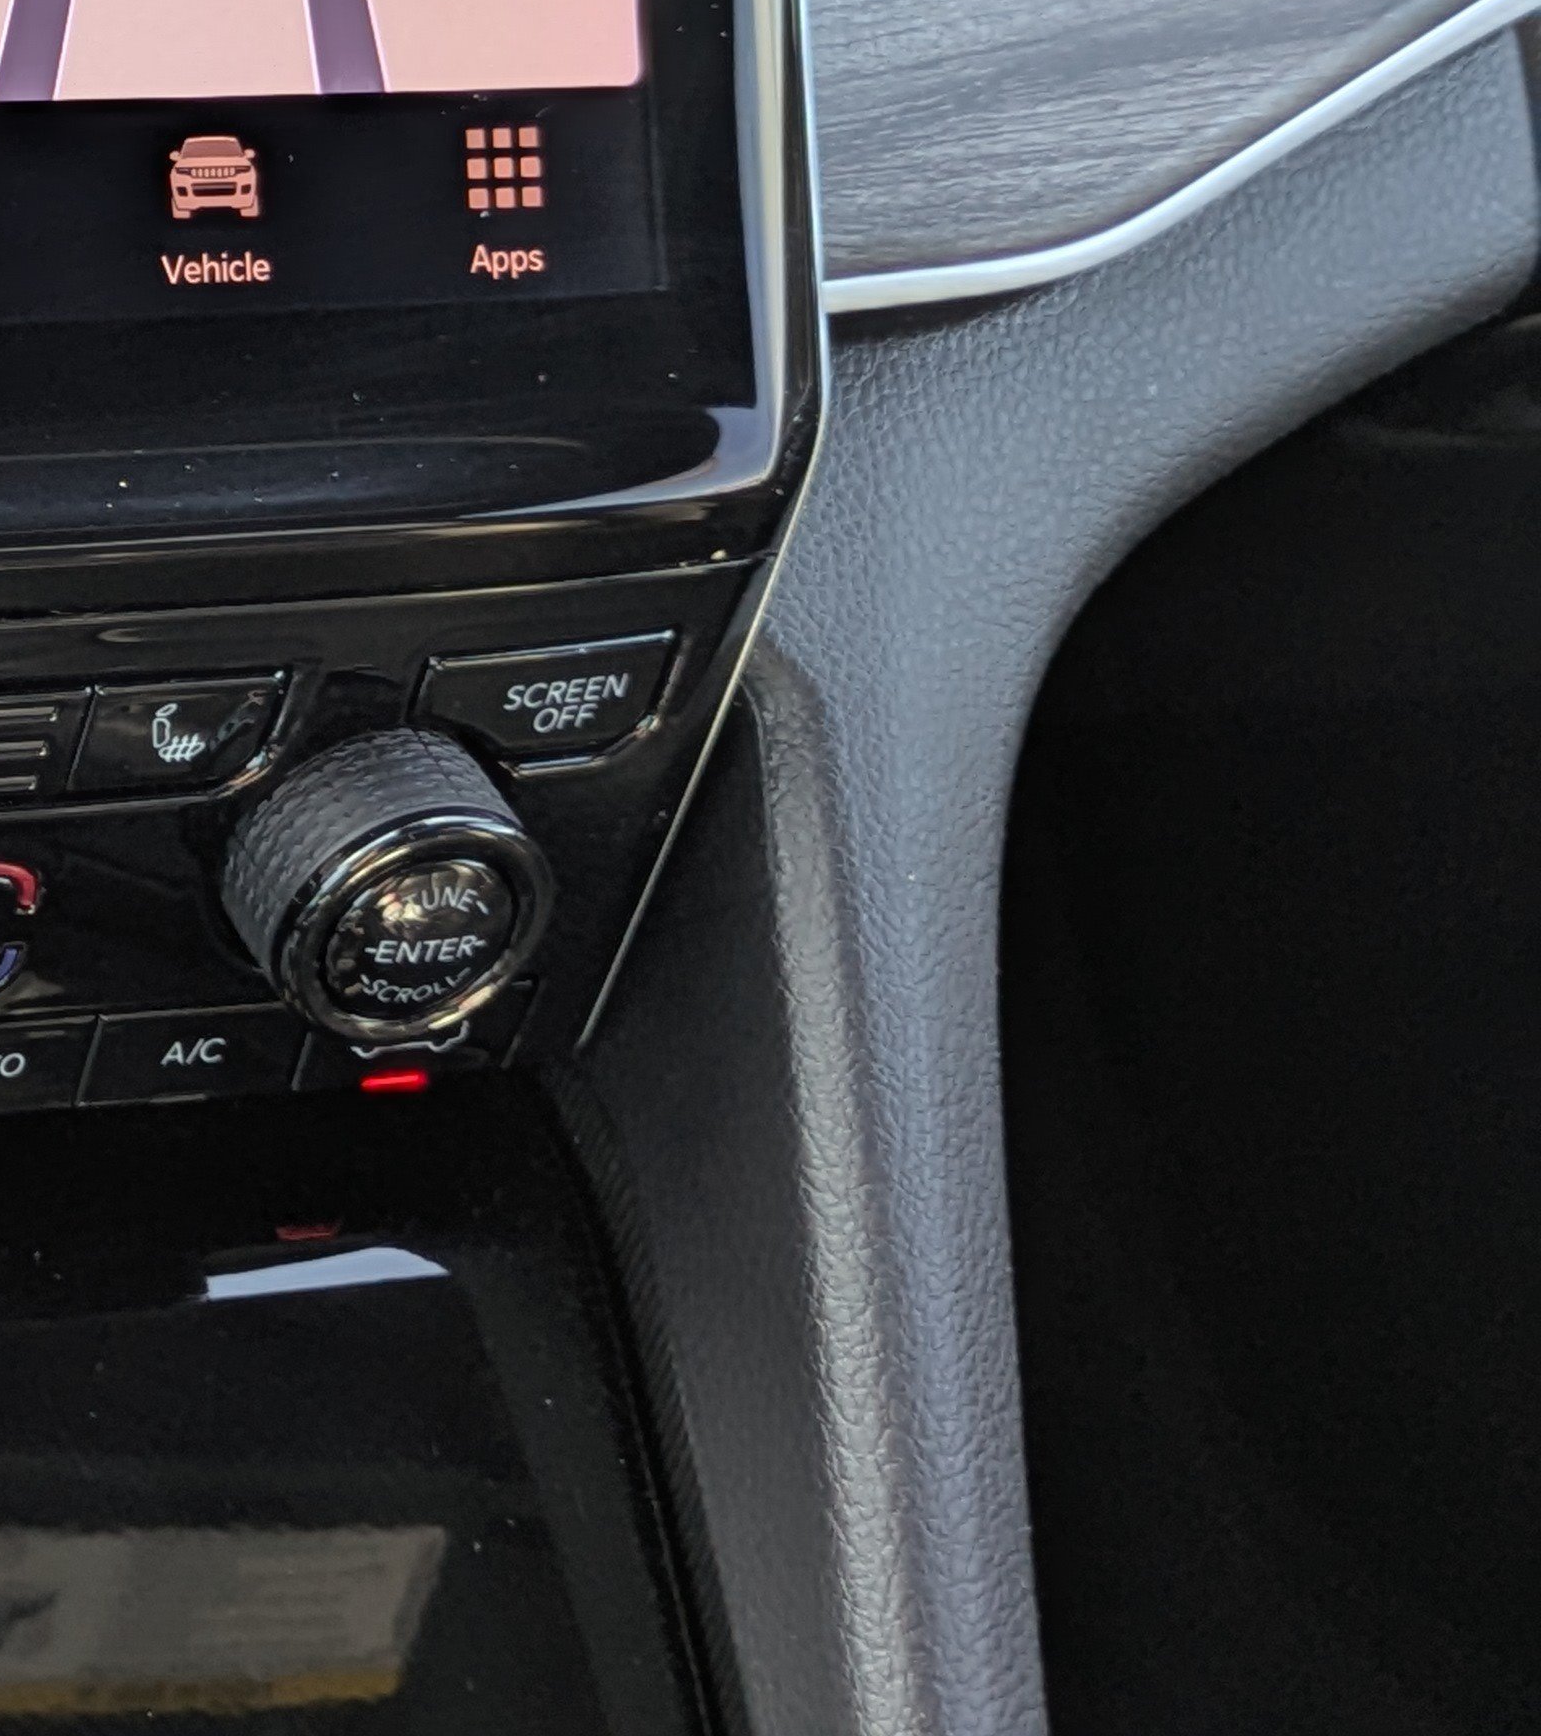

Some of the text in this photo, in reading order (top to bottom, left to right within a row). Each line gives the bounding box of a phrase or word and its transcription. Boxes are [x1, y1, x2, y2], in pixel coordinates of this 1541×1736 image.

[161, 251, 272, 286] Vehicle
[469, 243, 545, 279] Apps
[503, 673, 629, 711] SCREEN
[532, 706, 598, 734] OFF
[375, 937, 477, 966] ENTER
[160, 1037, 228, 1068] A/C
